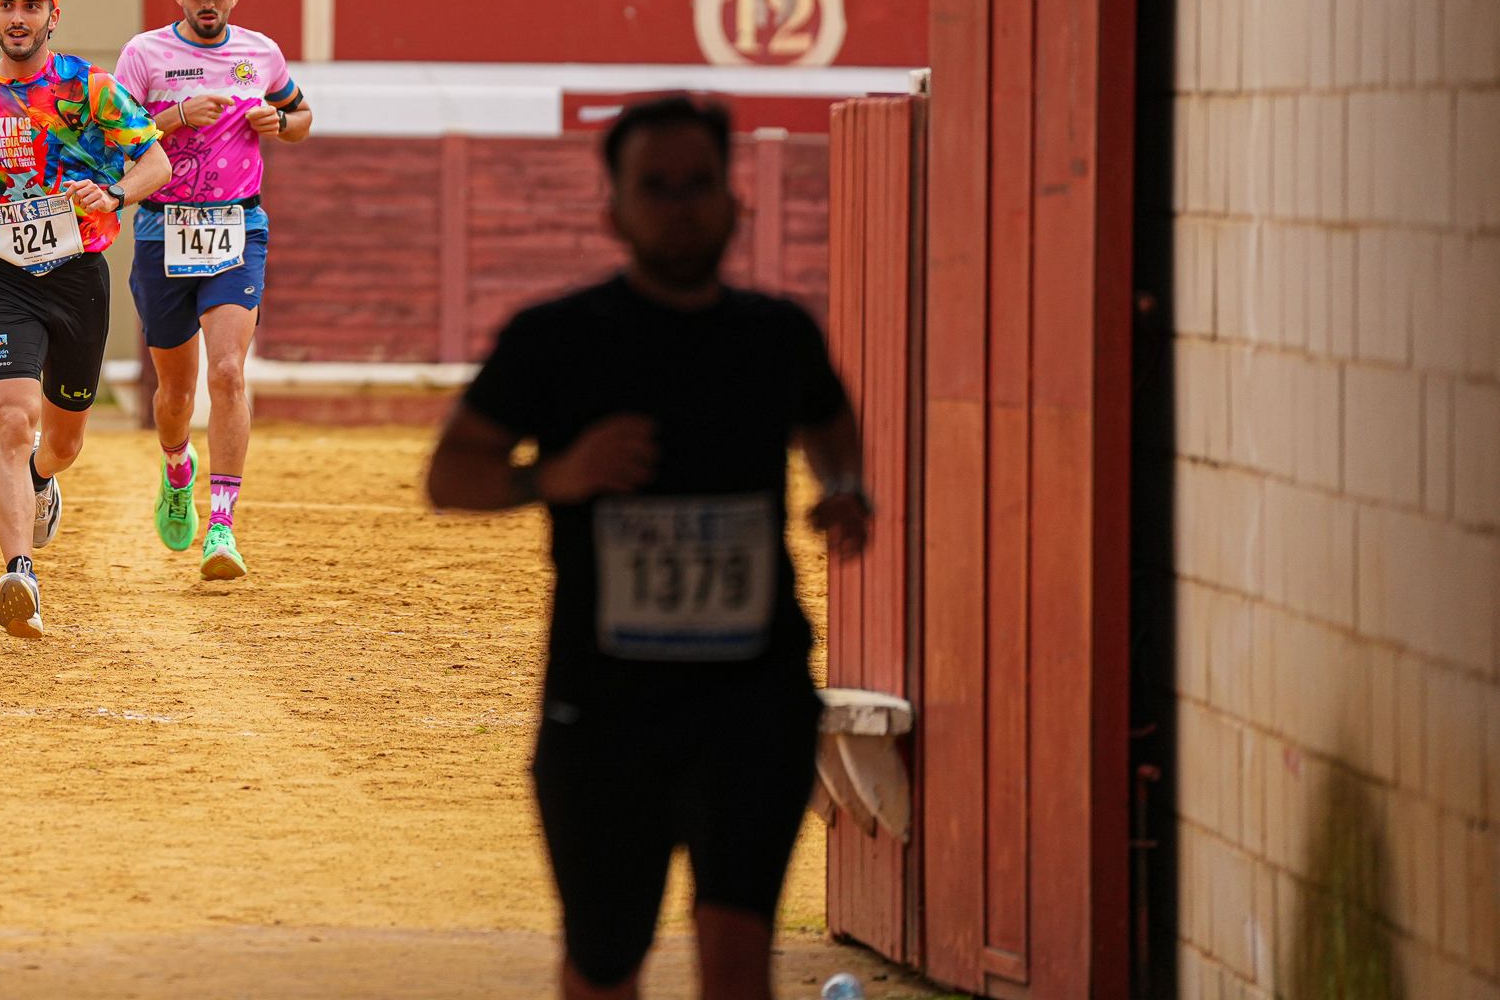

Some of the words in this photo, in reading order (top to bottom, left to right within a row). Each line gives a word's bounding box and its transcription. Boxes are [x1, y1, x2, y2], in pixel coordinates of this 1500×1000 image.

[165, 68, 204, 78] IMPARABLES
[1, 204, 25, 224] 21K
[12, 220, 58, 255] 524
[177, 228, 232, 255] 1474
